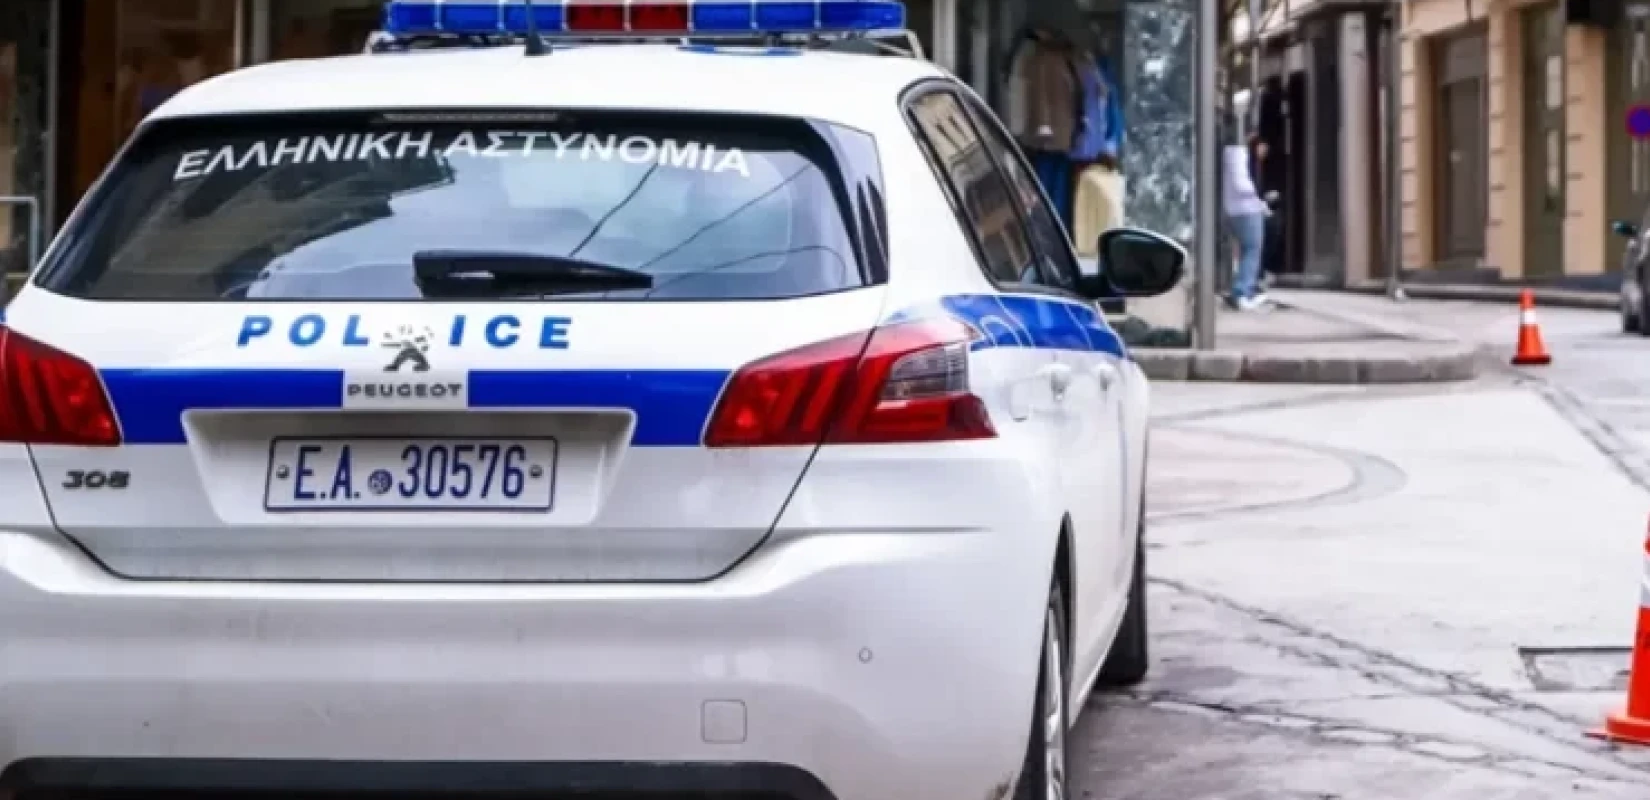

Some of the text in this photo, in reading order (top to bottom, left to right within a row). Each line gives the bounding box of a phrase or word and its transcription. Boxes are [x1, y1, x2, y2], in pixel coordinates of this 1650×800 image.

[173, 131, 751, 182] ΕΛΛΗΝΙΚΗ ΑΣΤΥΝΟΜΙΑ
[347, 383, 462, 397] PEUGEOT
[62, 470, 131, 489] 308
[398, 444, 527, 499] 30576
